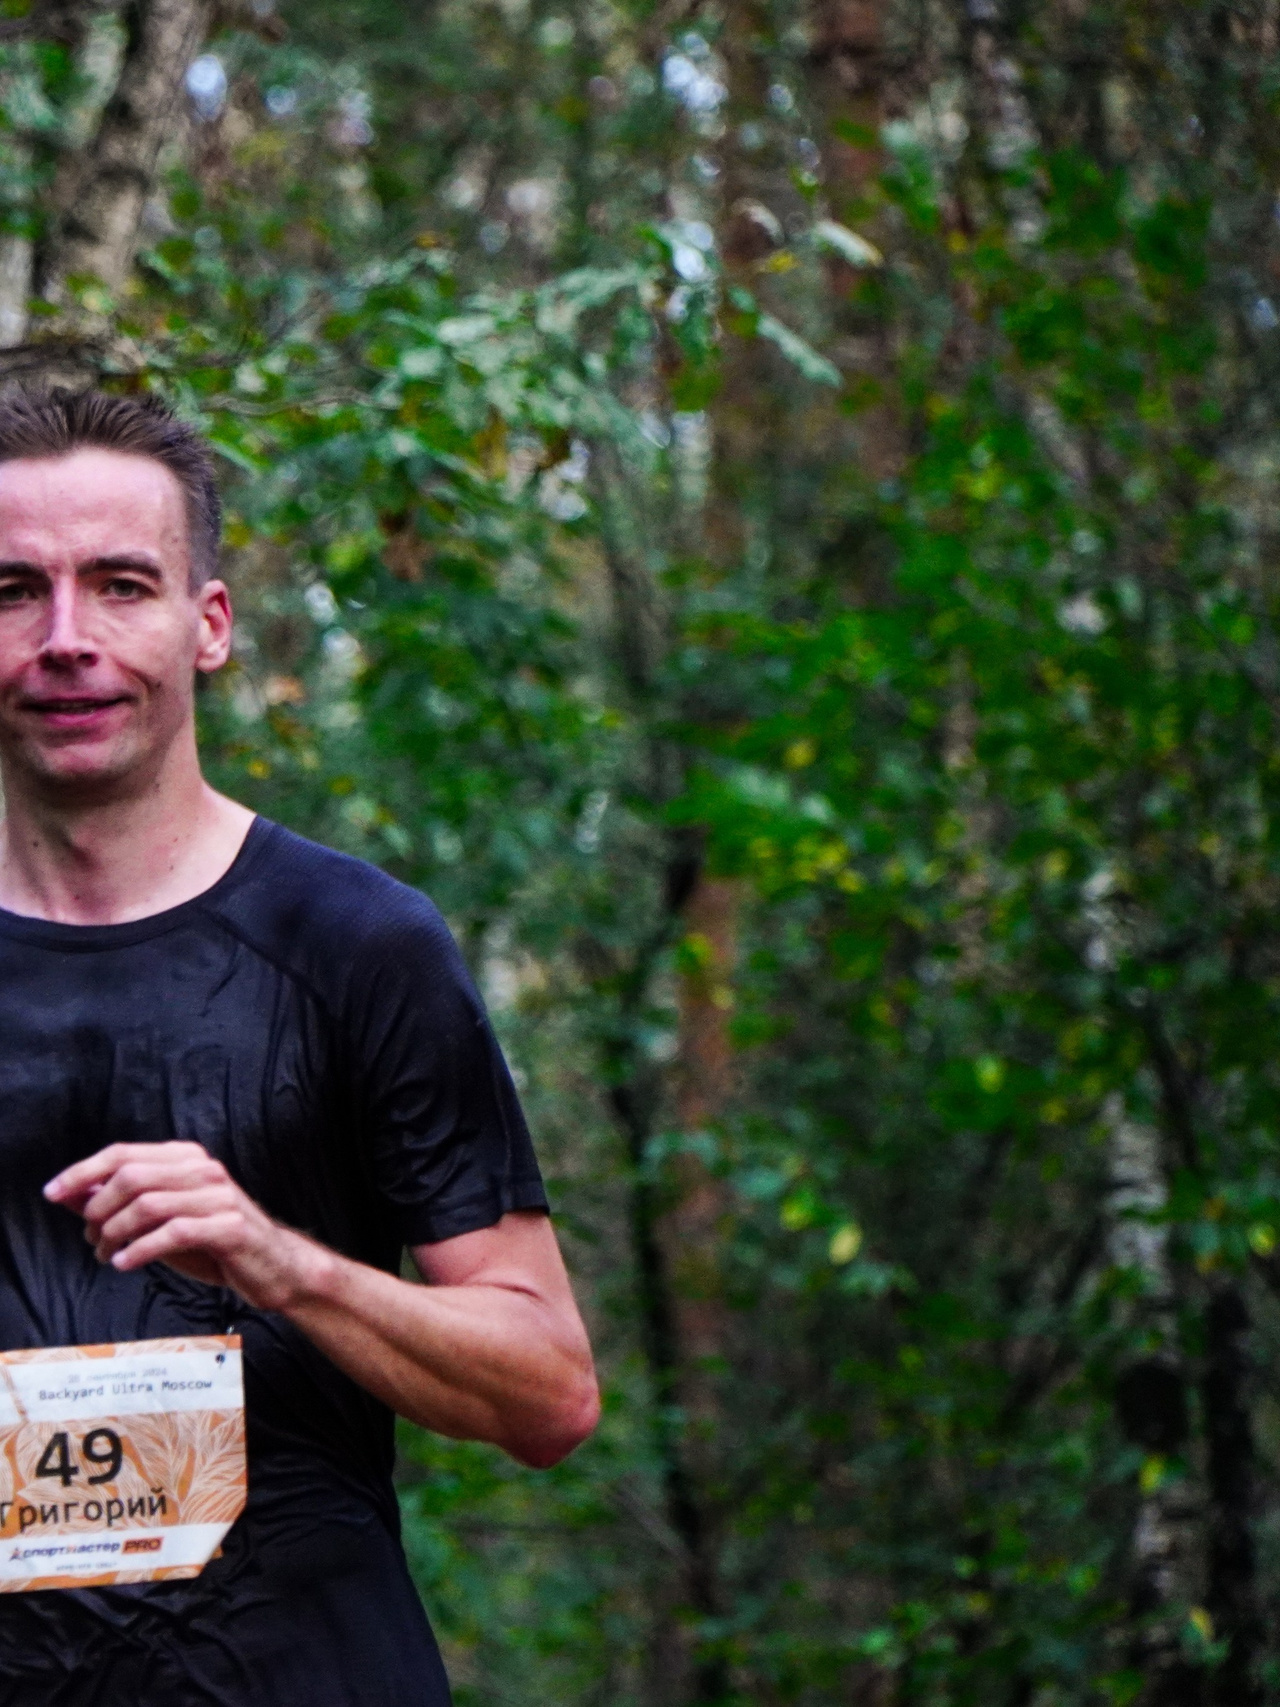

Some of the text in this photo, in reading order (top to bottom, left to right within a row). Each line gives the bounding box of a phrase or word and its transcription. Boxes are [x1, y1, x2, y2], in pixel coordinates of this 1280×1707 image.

[38, 1380, 213, 1402] Backyard Ultra Moscow
[34, 1427, 123, 1487] 49
[123, 1538, 162, 1553] PRO
